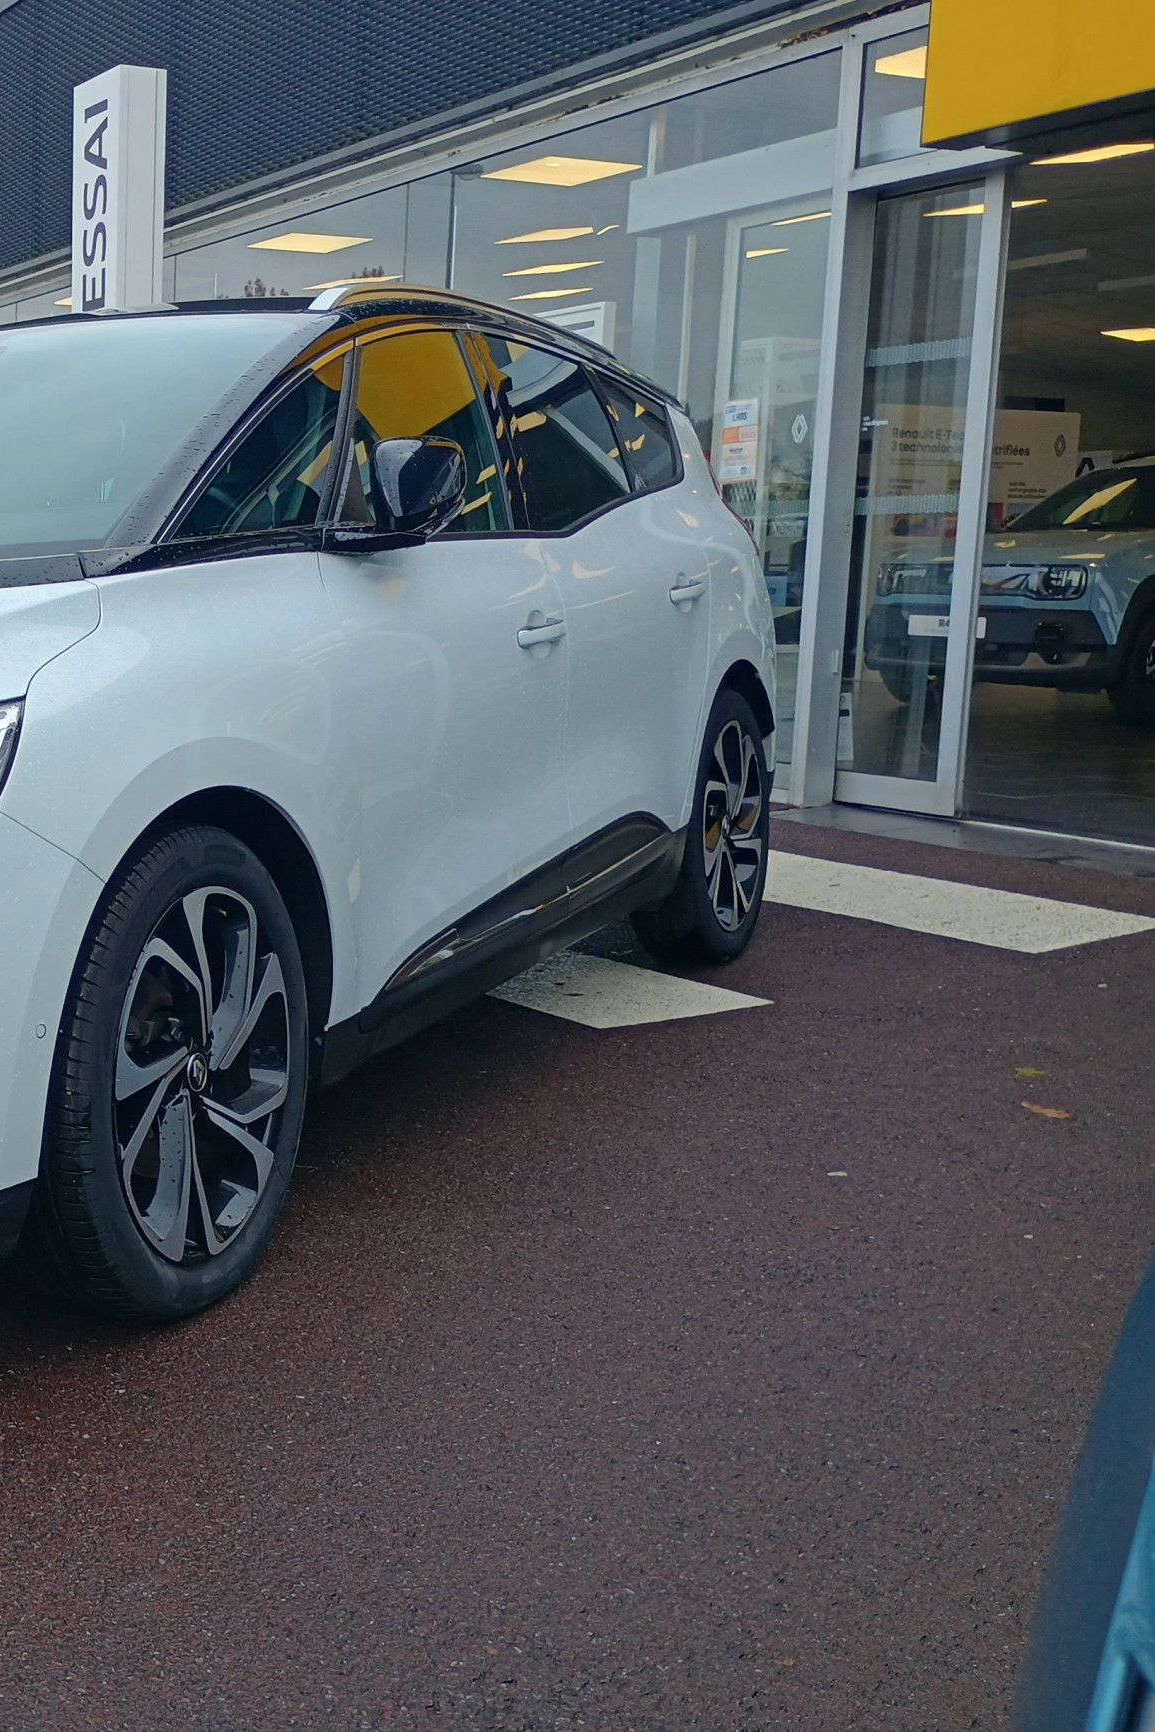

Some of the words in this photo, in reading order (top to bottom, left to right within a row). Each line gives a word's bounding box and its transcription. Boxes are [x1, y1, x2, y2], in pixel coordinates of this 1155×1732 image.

[82, 98, 109, 312] ESSAI
[892, 427, 934, 441] Renault
[890, 441, 896, 451] 3
[898, 442, 963, 456] technologie
